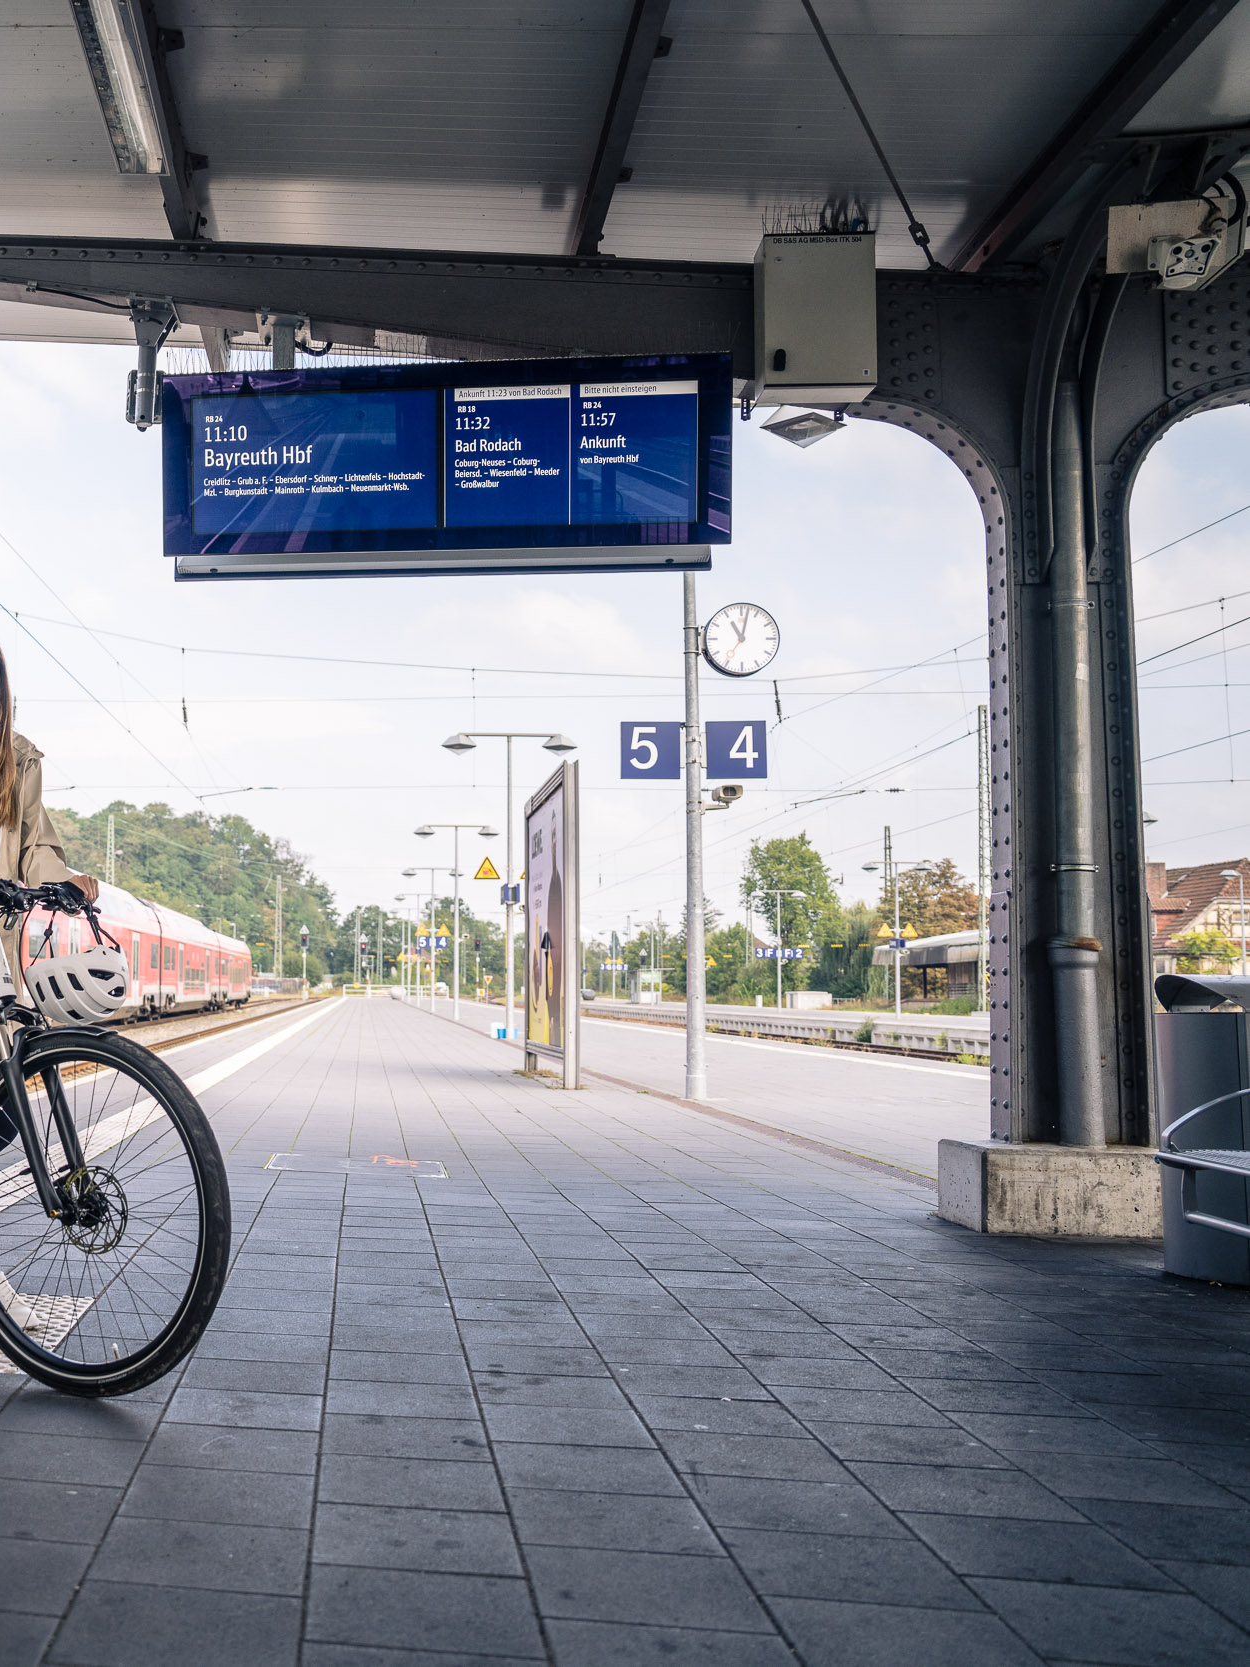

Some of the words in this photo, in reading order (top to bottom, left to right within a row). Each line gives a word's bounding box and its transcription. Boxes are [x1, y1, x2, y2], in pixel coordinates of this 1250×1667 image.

[458, 390, 485, 398] Ankunft
[487, 389, 507, 397] 11:23
[522, 388, 535, 396] Bad
[537, 387, 562, 395] Rodach
[585, 386, 601, 394] Bitte
[602, 385, 619, 393] nicht
[621, 385, 657, 393] einsteigen
[456, 416, 491, 430] 11:32
[581, 413, 616, 426] 11:57
[204, 425, 247, 442] 11:10
[455, 439, 477, 452] Bad
[480, 438, 521, 452] Rodach
[580, 435, 626, 449] Ankunft
[204, 446, 277, 471] Bayreuth
[283, 444, 312, 464] Hbf
[455, 458, 506, 468] Coburg-Neuses
[513, 457, 540, 467] Coburg-
[594, 455, 624, 465] Bayreuth
[626, 454, 639, 463] Hbf
[455, 469, 482, 478] Beiersd.
[490, 468, 526, 477] Wiesenfeld
[534, 467, 560, 476] Meeder
[204, 478, 230, 486] Creidlitz
[237, 477, 253, 485] Grub
[262, 476, 268, 484] F.
[275, 475, 307, 483] Ebersdorf
[314, 474, 337, 483] Schney
[345, 473, 381, 482] Lichtenfels
[388, 472, 425, 480] Hochstadt-
[461, 480, 499, 488] Großwalbur
[224, 487, 268, 497] Burgkunstadt
[275, 486, 304, 494] Mainroth
[312, 484, 343, 493] Kulmbach
[351, 483, 409, 492] Neuenmarkt-Wsb.
[630, 727, 658, 770] 5
[730, 726, 758, 768] 4
[420, 937, 427, 947] 5
[439, 937, 447, 947] 4
[756, 948, 763, 958] 3
[796, 949, 803, 958] 2
